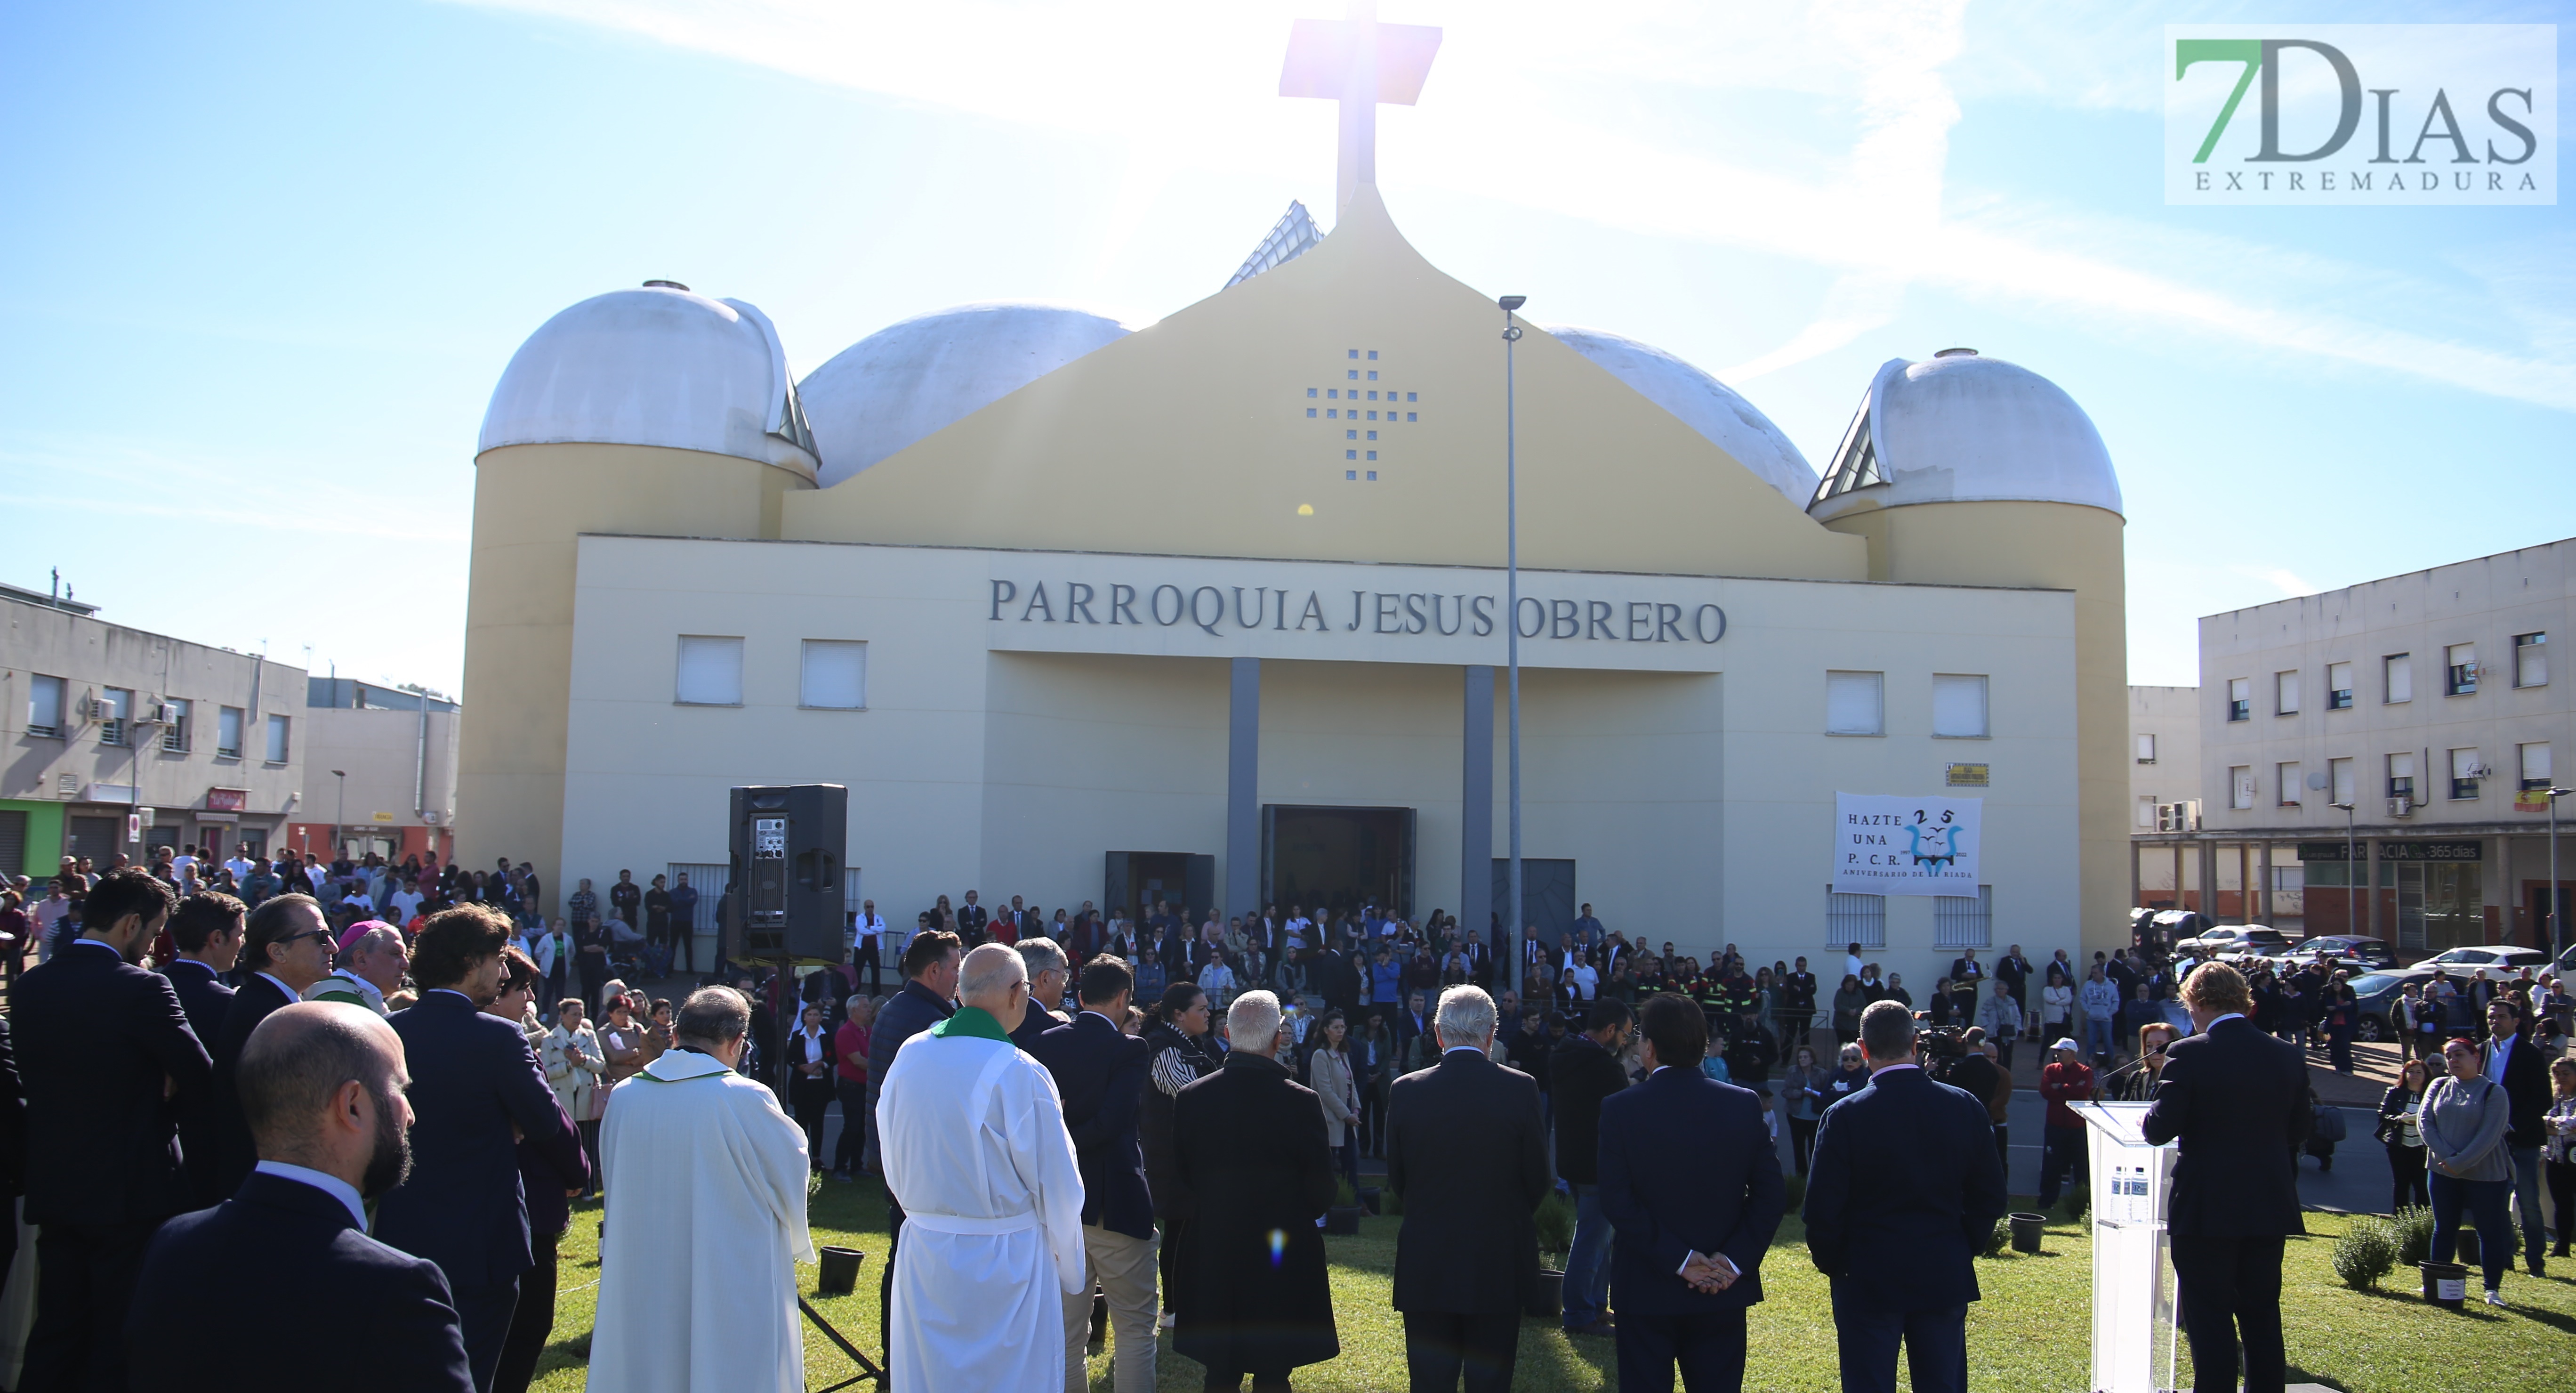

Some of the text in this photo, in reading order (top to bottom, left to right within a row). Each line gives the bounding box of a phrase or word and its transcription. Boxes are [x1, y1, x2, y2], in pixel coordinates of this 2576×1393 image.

[989, 579, 1727, 644] PARROQUIA JESUS OBRERO
[1848, 814, 1901, 826] HAZTE
[1853, 834, 1887, 845] UNA
[2341, 844, 2409, 858] FARACIA
[2453, 845, 2476, 857] días
[1843, 869, 1907, 878] ANIVERSARIO
